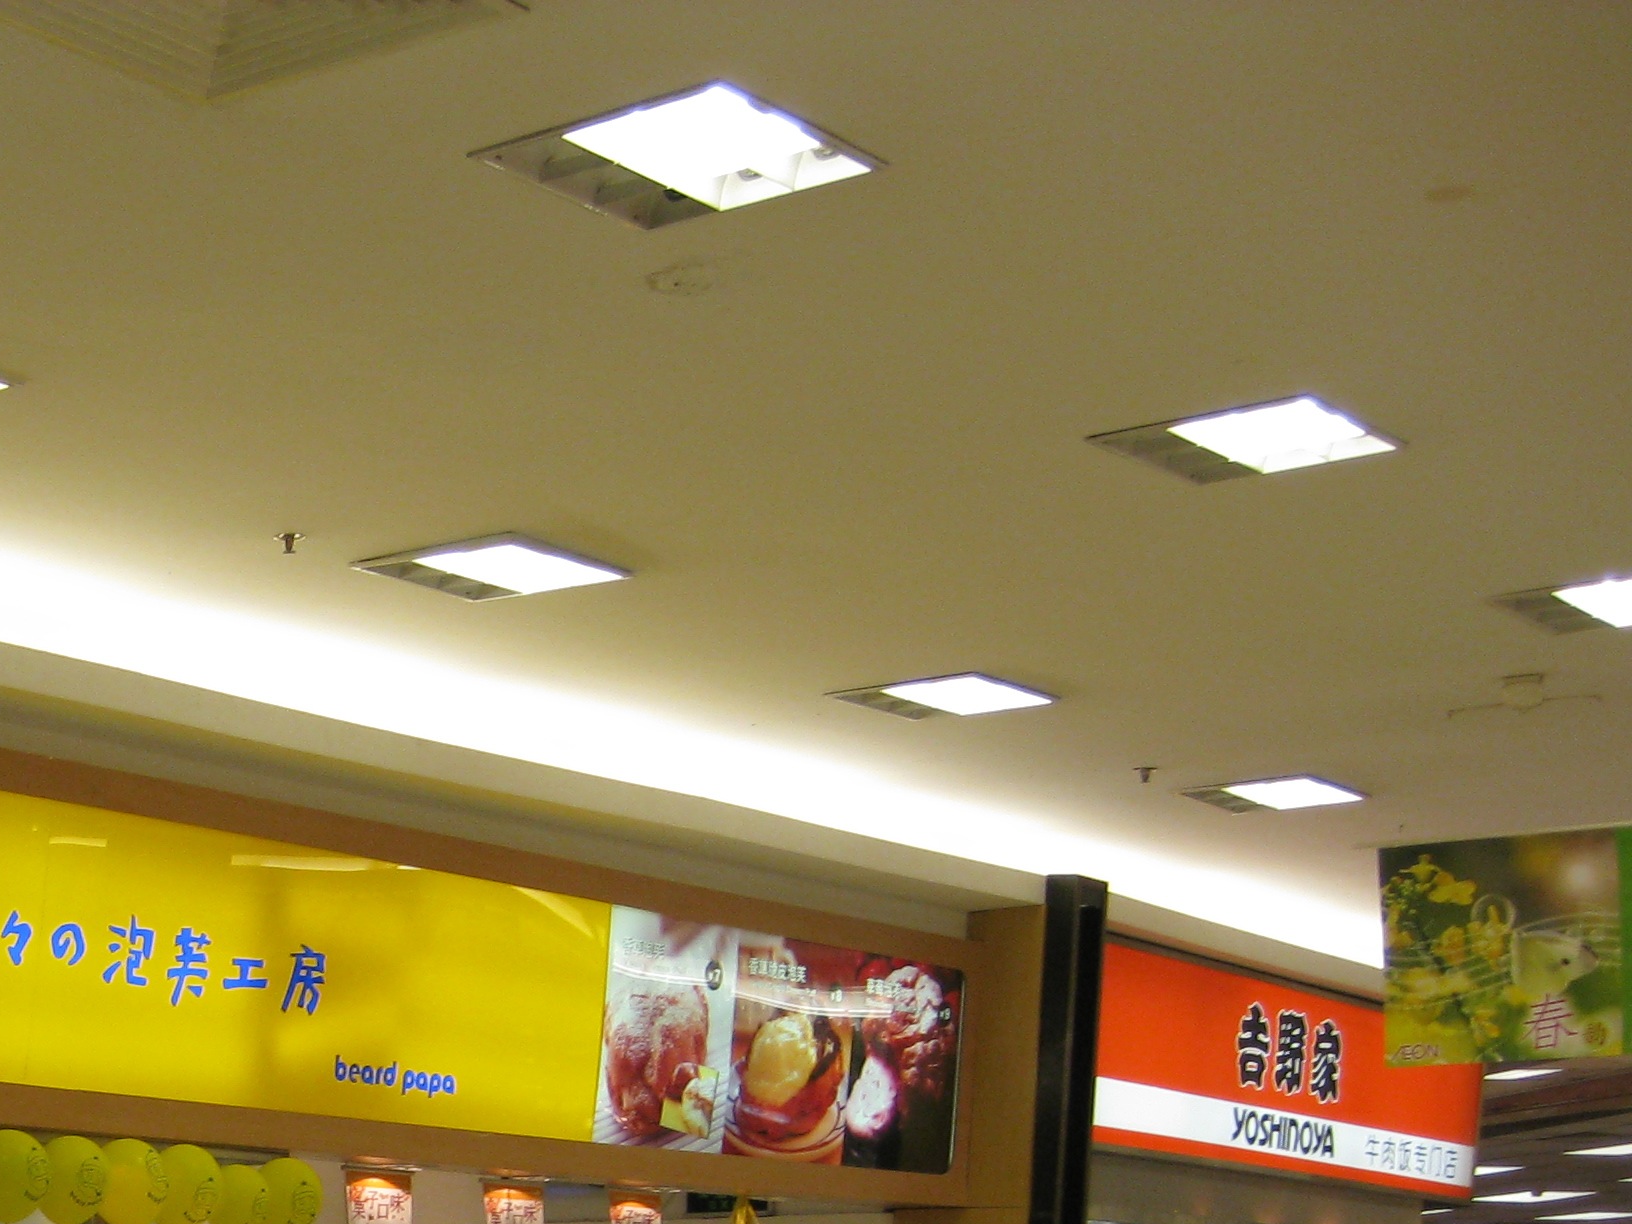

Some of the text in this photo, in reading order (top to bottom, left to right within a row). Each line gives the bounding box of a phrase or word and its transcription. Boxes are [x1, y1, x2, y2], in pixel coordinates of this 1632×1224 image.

[1519, 993, 1578, 1050] 春
[335, 1054, 456, 1098] beard papa
[1235, 1001, 1343, 1105] 吉野家
[1231, 1106, 1335, 1158] YOSHINOYA
